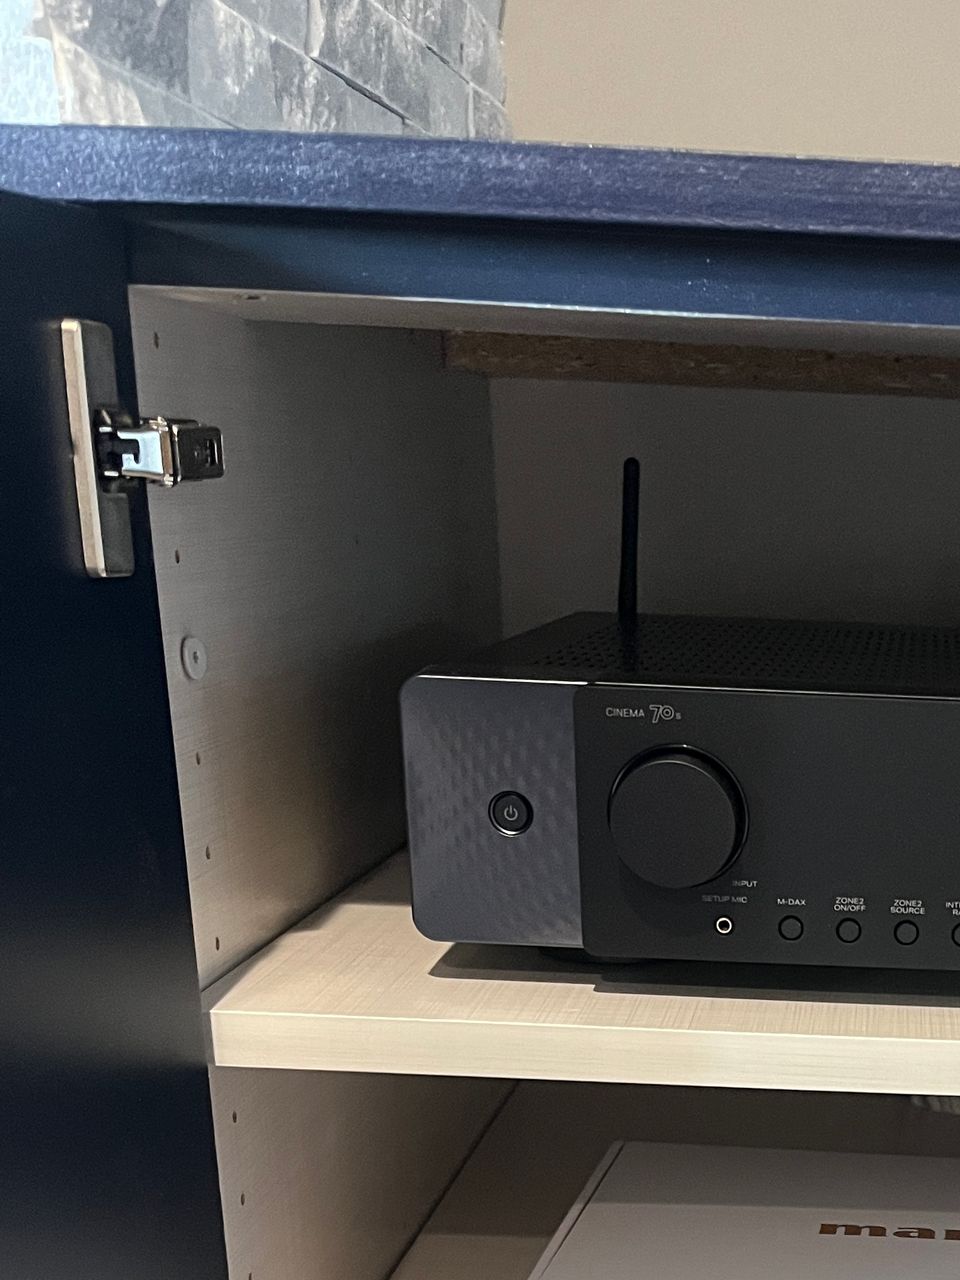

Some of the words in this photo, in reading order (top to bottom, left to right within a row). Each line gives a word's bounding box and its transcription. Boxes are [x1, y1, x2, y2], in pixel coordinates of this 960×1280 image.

[605, 706, 645, 718] CINEMA
[777, 898, 807, 906] M-DAX
[834, 896, 865, 905] ZONE2
[893, 899, 923, 908] ZONE2
[833, 904, 867, 912] ON/OFF
[890, 906, 926, 915] SOURCE
